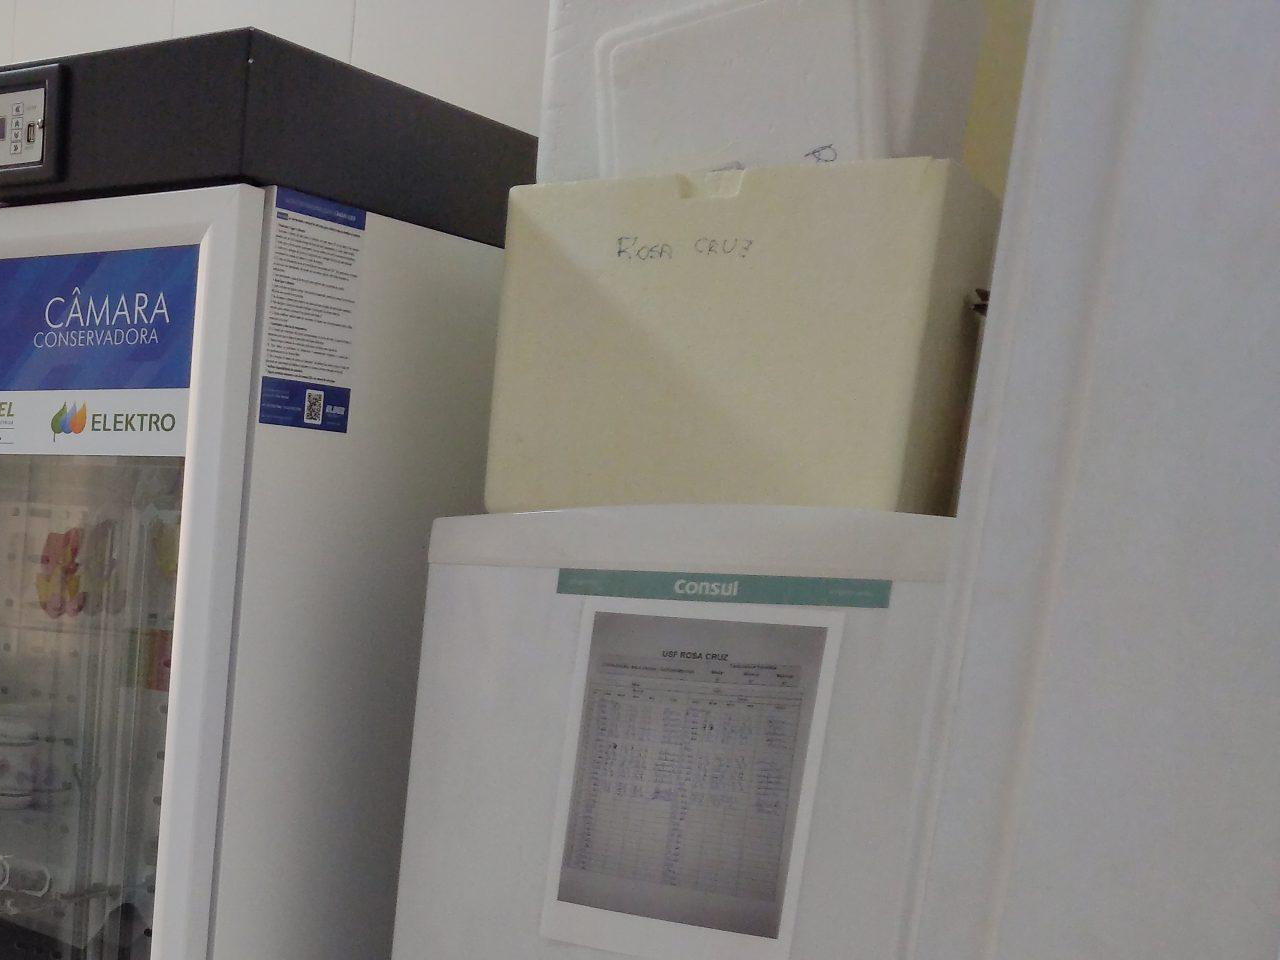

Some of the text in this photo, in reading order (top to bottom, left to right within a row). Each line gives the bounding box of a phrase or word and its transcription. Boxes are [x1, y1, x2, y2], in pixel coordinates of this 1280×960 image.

[44, 286, 170, 329] CÂMARA
[33, 327, 159, 349] CONSERVADORA
[91, 412, 176, 433] ELEKTRO
[662, 650, 729, 662] USF ROSA CRUZ
